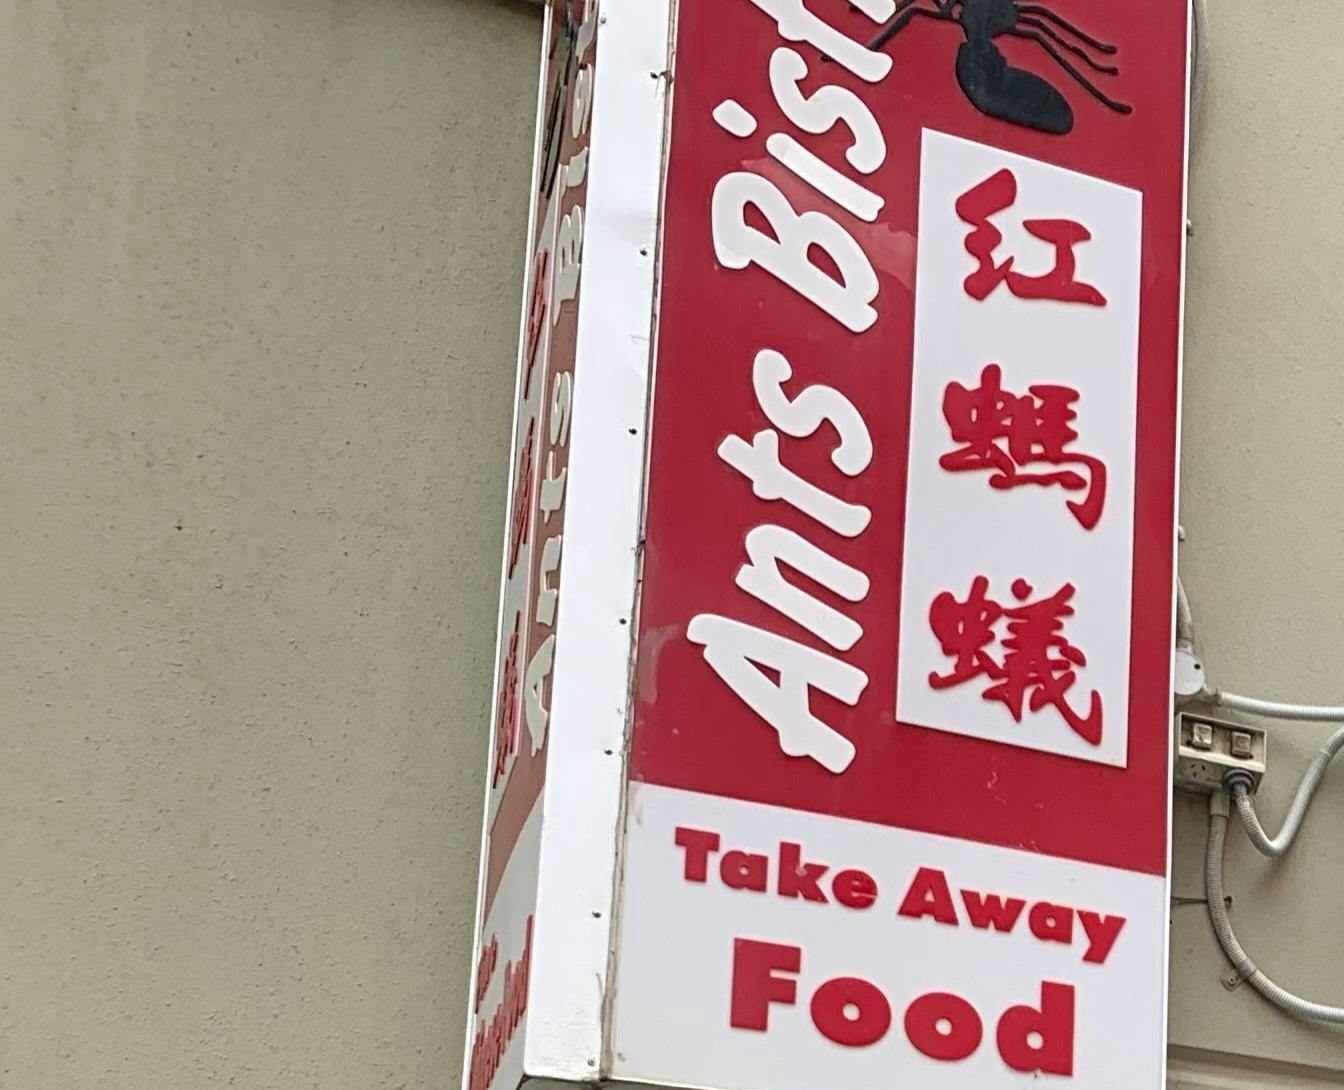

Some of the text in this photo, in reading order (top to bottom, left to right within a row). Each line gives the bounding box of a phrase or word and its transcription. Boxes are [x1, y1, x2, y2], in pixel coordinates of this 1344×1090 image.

[686, 0, 897, 774] Ants Bist
[674, 826, 1127, 964] Take Away
[729, 937, 1075, 1077] Food
